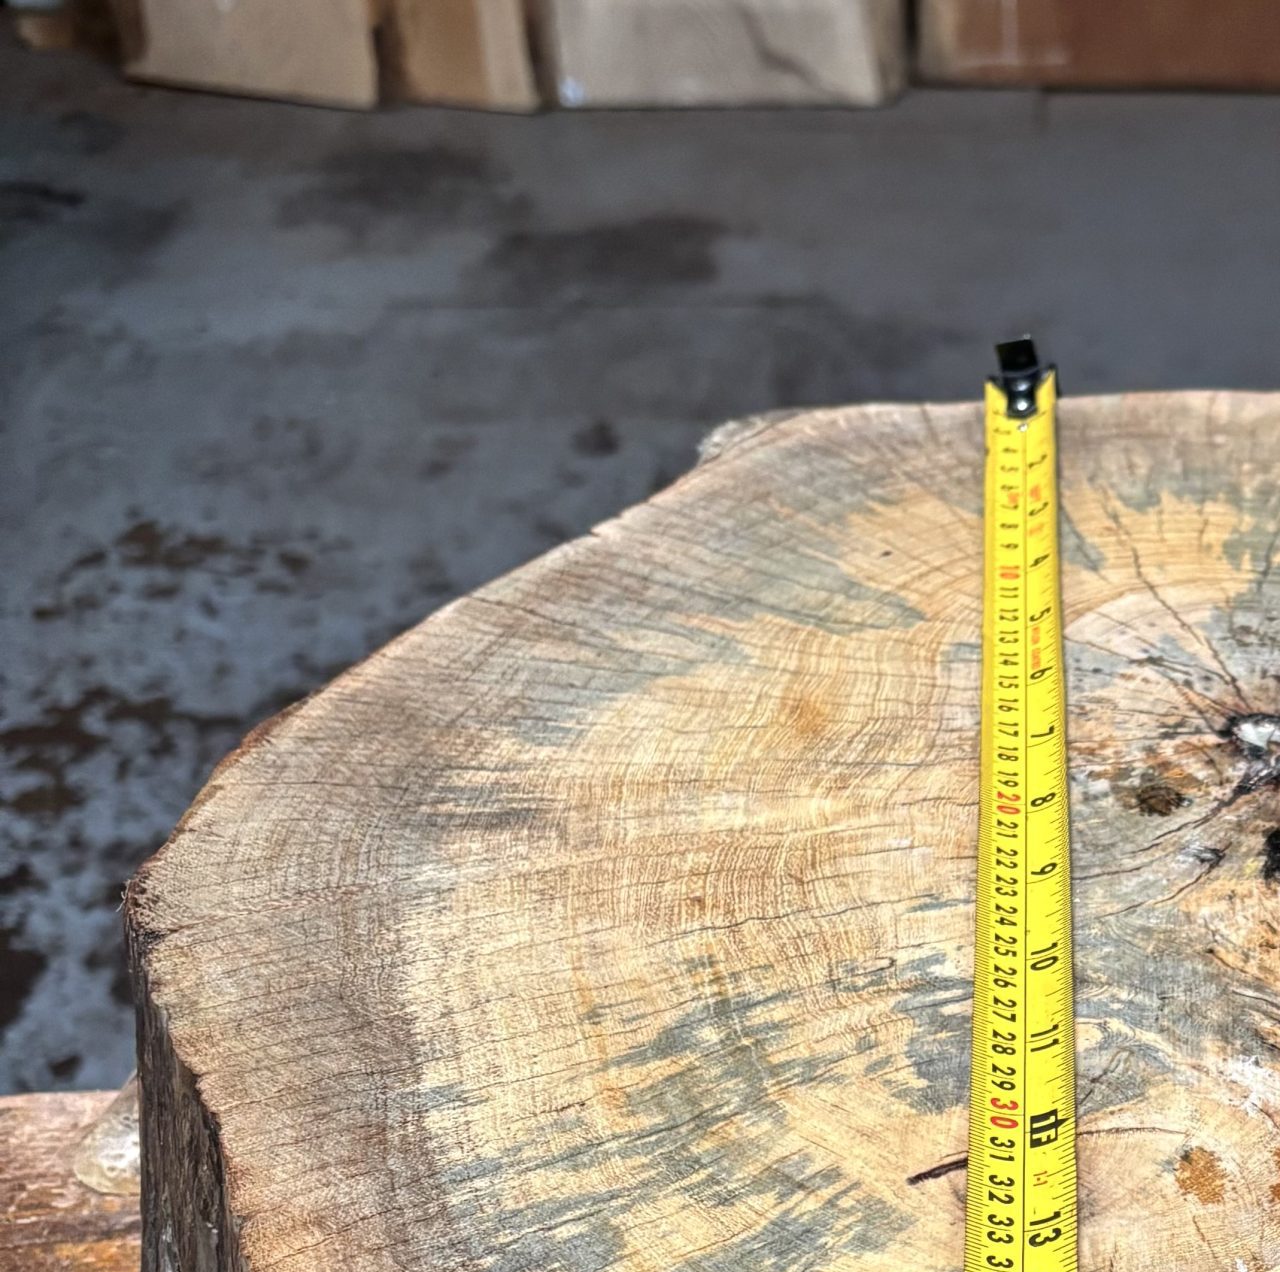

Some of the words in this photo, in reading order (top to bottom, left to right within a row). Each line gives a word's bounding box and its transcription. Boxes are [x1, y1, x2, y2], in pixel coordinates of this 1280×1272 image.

[999, 565, 1020, 580] 10
[999, 587, 1019, 598] 11
[999, 608, 1019, 622] 12
[1029, 606, 1052, 623] 5
[999, 630, 1019, 643] 13
[999, 652, 1019, 666] 14
[998, 674, 1019, 689] 15
[1029, 666, 1053, 680] 6
[998, 698, 1019, 712] 16
[998, 721, 1019, 737] 17
[1030, 725, 1055, 739] 7
[997, 745, 1019, 761] 18
[997, 770, 1019, 787] 19
[996, 791, 1021, 815] 20
[1030, 792, 1056, 807] 8
[996, 818, 1019, 839] 21
[996, 846, 1018, 869] 22
[1030, 862, 1058, 876] 9
[995, 875, 1018, 897] 23
[994, 904, 1018, 926] 24
[994, 933, 1018, 957] 25
[1030, 942, 1059, 971] 10
[993, 964, 1017, 988] 26
[992, 995, 1017, 1023] 27
[991, 1029, 1016, 1056] 28
[1030, 1023, 1060, 1052] 11
[991, 1063, 1016, 1091] 29
[990, 1097, 1019, 1129] 30
[989, 1136, 1015, 1162] 31
[988, 1174, 1015, 1204] 32
[986, 1213, 1014, 1244] 33
[1028, 1211, 1062, 1247] 13
